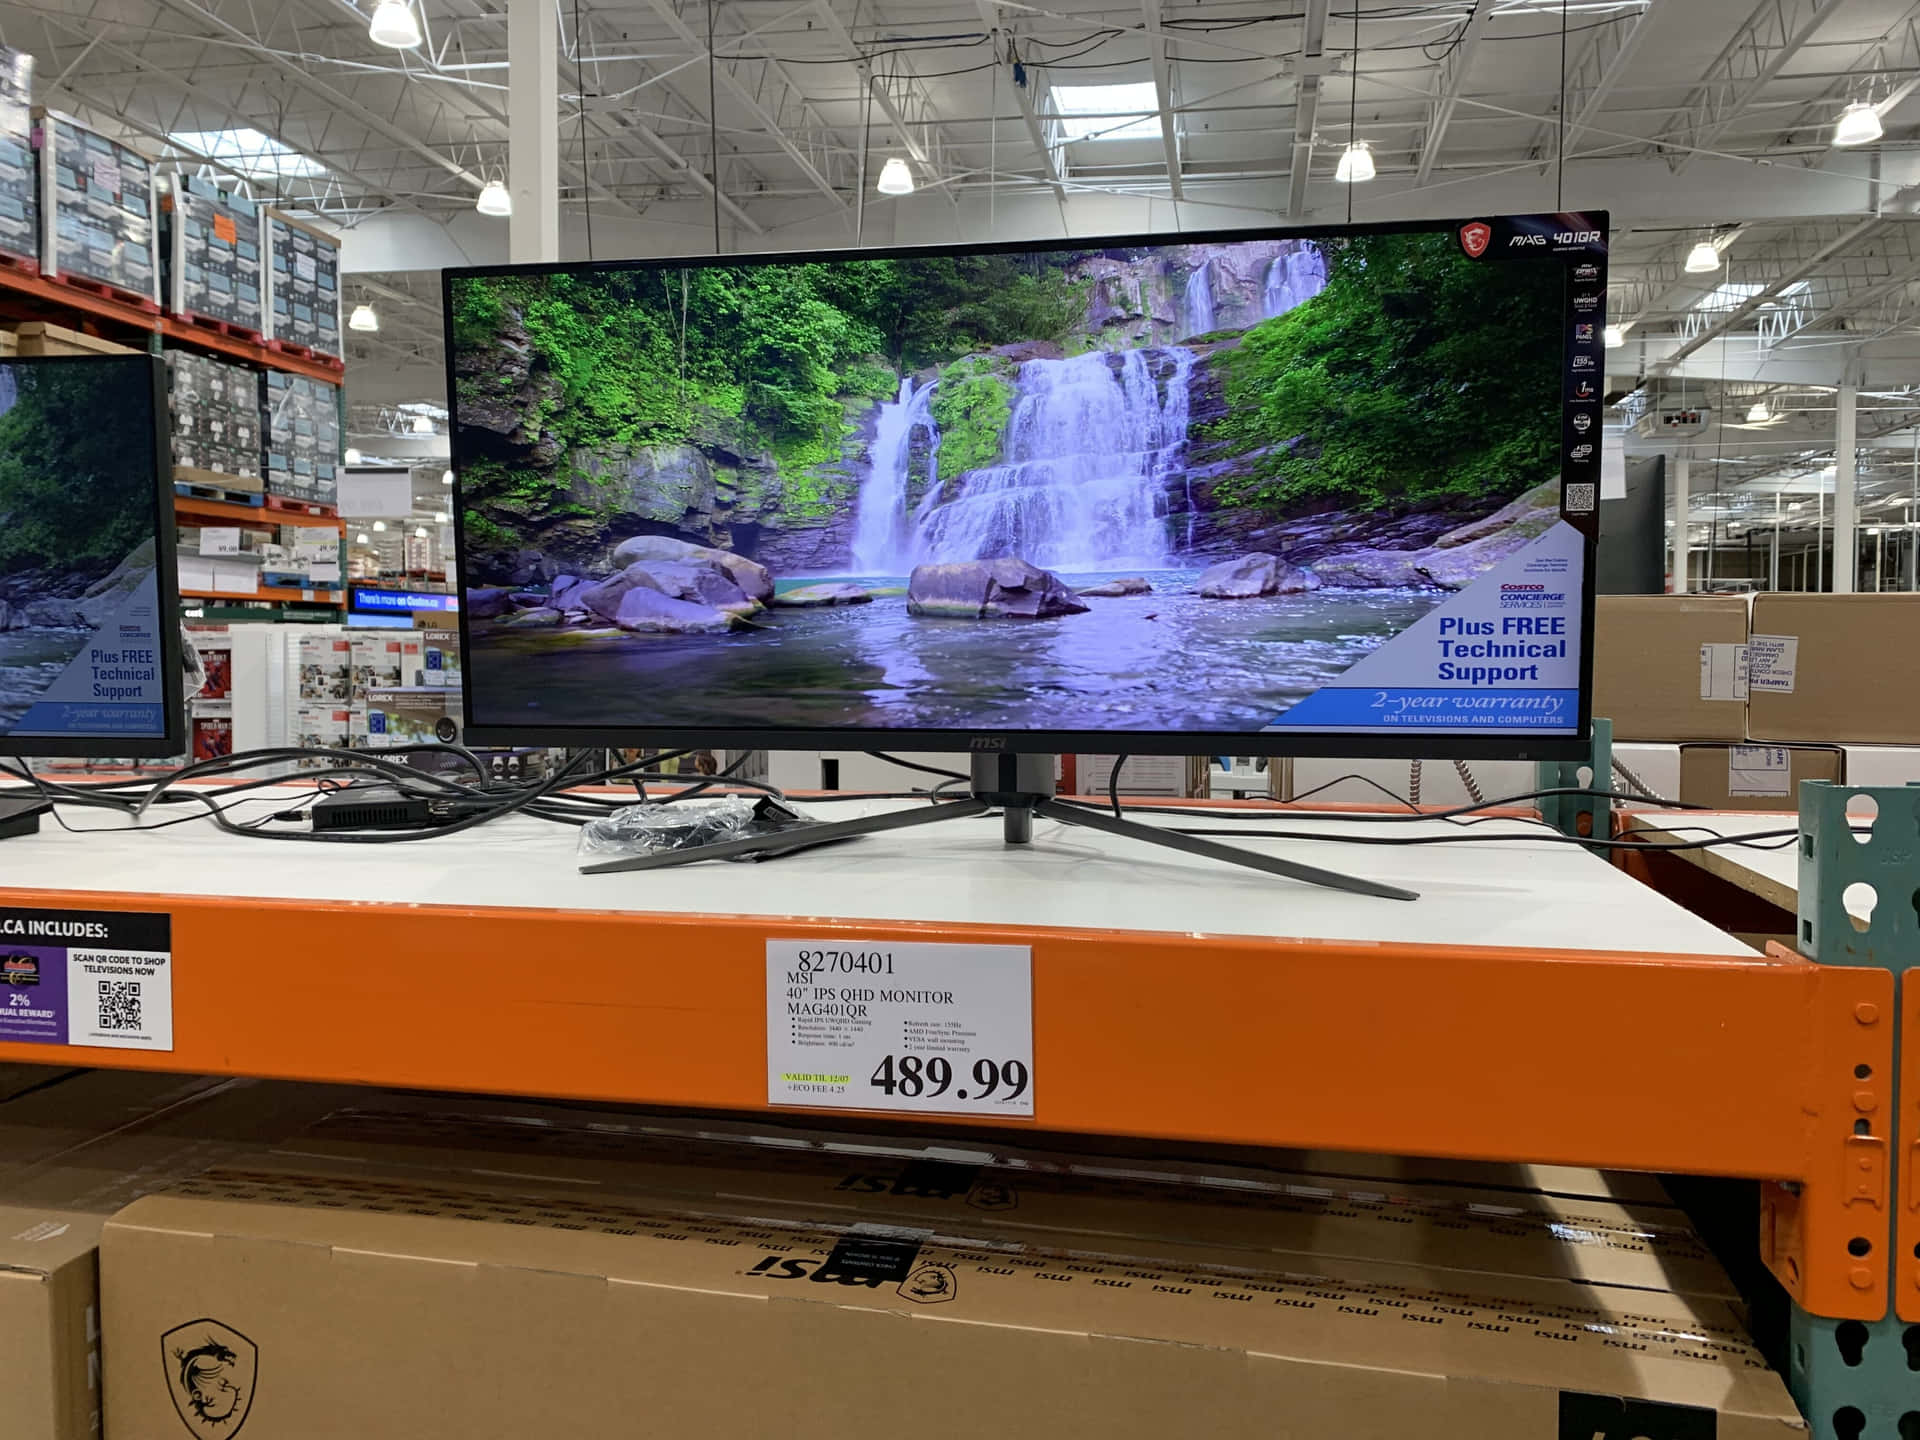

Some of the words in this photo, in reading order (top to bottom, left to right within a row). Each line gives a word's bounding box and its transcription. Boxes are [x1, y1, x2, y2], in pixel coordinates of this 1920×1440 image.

[1509, 234, 1546, 246] MAG
[1554, 231, 1600, 244] 401QR
[1440, 618, 1494, 635] Plus
[1502, 617, 1565, 635] FREE
[1439, 640, 1566, 658] Technical
[91, 650, 119, 663] Plus
[122, 650, 153, 663] FREE
[91, 666, 154, 680] Technical
[1438, 663, 1538, 685] Support
[93, 683, 142, 700] Support
[368, 694, 393, 702] LOREX
[1371, 691, 1448, 713] 2-year
[1452, 694, 1563, 715] warranty
[1400, 714, 1468, 723] TELEVISIONS
[1472, 715, 1494, 724] AND
[1498, 715, 1564, 724] COMPUTERS
[969, 736, 1007, 749] msi
[28, 920, 108, 938] INCLUDES:
[73, 954, 94, 962] SCAN
[96, 955, 107, 964] QR
[109, 956, 130, 964] CODE
[132, 956, 142, 965] TO
[144, 957, 166, 966] SHOP
[798, 950, 894, 974] 8270401
[84, 965, 133, 974] TELEVISIONS
[135, 968, 155, 976] NOW
[787, 972, 814, 985] MSI
[10, 994, 30, 1007] 2%
[786, 987, 808, 1000] 40"
[814, 988, 835, 1000] IPS
[840, 988, 874, 1003] QHD
[880, 990, 953, 1004] MONITOR
[787, 1002, 867, 1018] MAG401QR
[785, 1073, 812, 1081] VALID
[870, 1055, 1028, 1100] 489.99
[977, 1266, 1016, 1276] msi
[1034, 1272, 1073, 1282] msi
[1092, 1278, 1132, 1289] msi
[1152, 1284, 1192, 1295] msi
[1213, 1291, 1253, 1302] msi
[1274, 1298, 1316, 1309] msi
[1337, 1305, 1380, 1316] msi
[1402, 1313, 1444, 1324] msi
[1467, 1321, 1510, 1333] msi
[1534, 1330, 1578, 1342] msi
[1603, 1339, 1647, 1351] msi
[1674, 1349, 1718, 1361] msi
